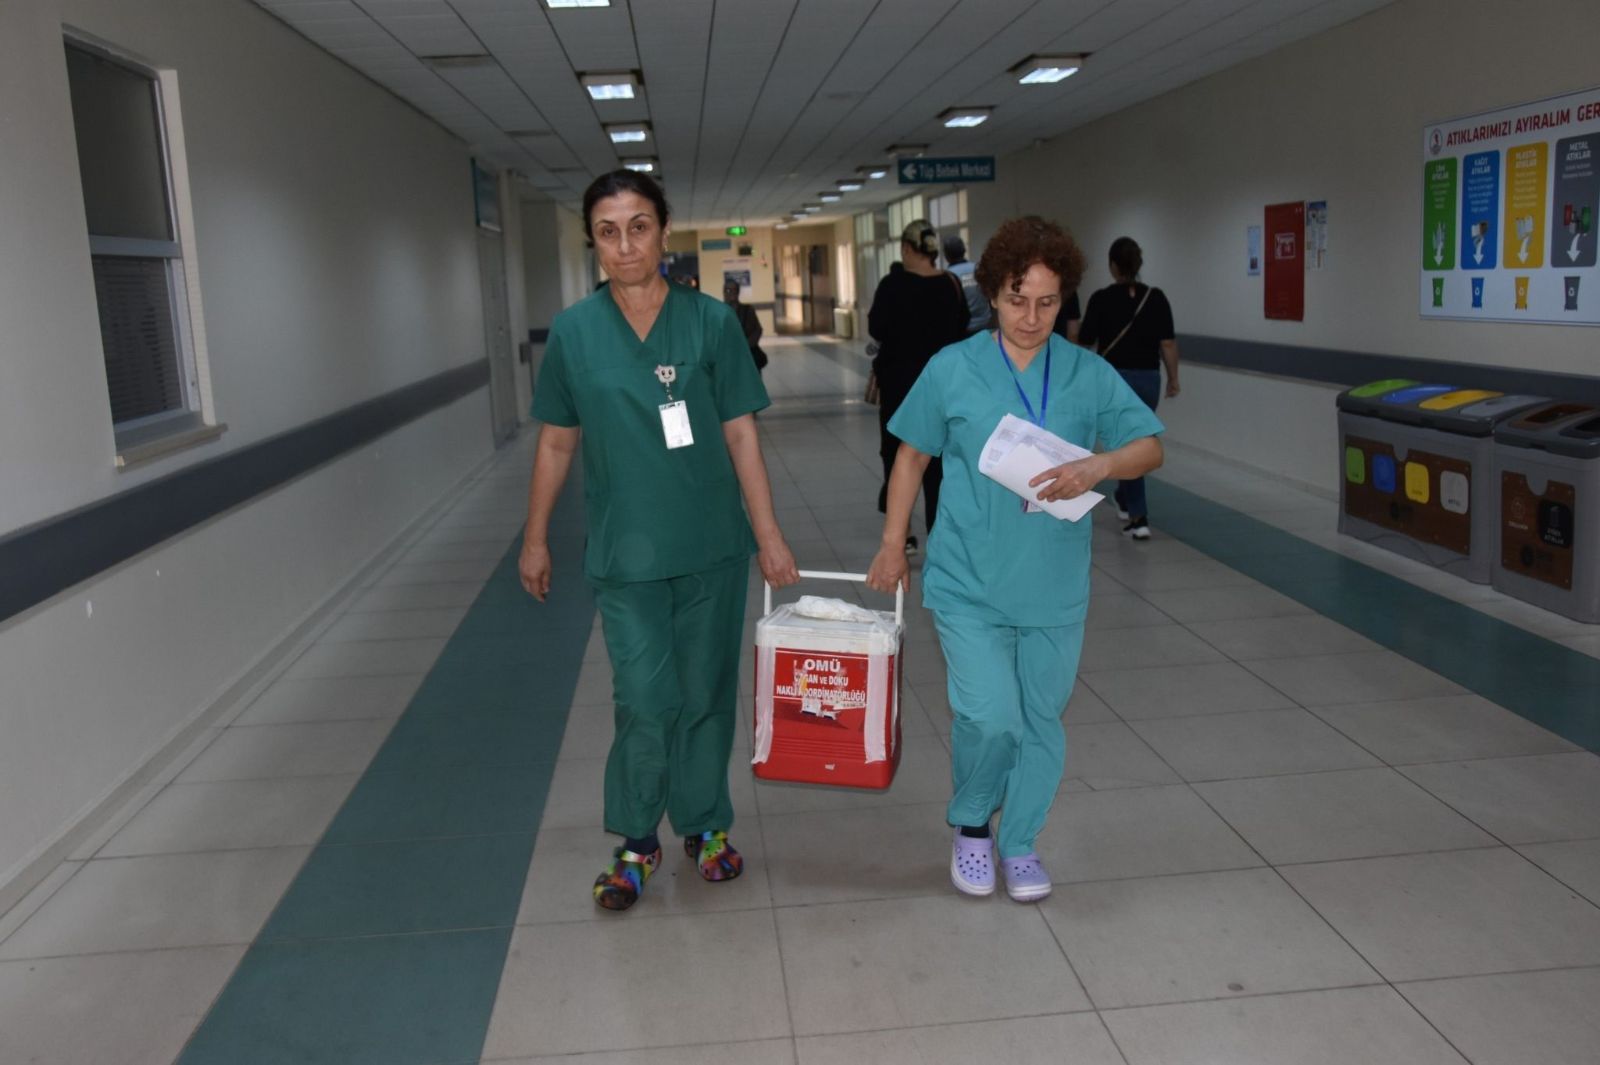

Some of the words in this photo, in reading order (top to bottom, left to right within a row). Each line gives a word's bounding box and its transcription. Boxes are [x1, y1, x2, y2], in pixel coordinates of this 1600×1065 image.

[1447, 120, 1511, 147] ATIKLARIMIZI
[1515, 108, 1570, 133] AYIRALIM
[918, 163, 934, 180] Tüp
[804, 658, 841, 672] OMÜ
[829, 676, 848, 687] DOKU
